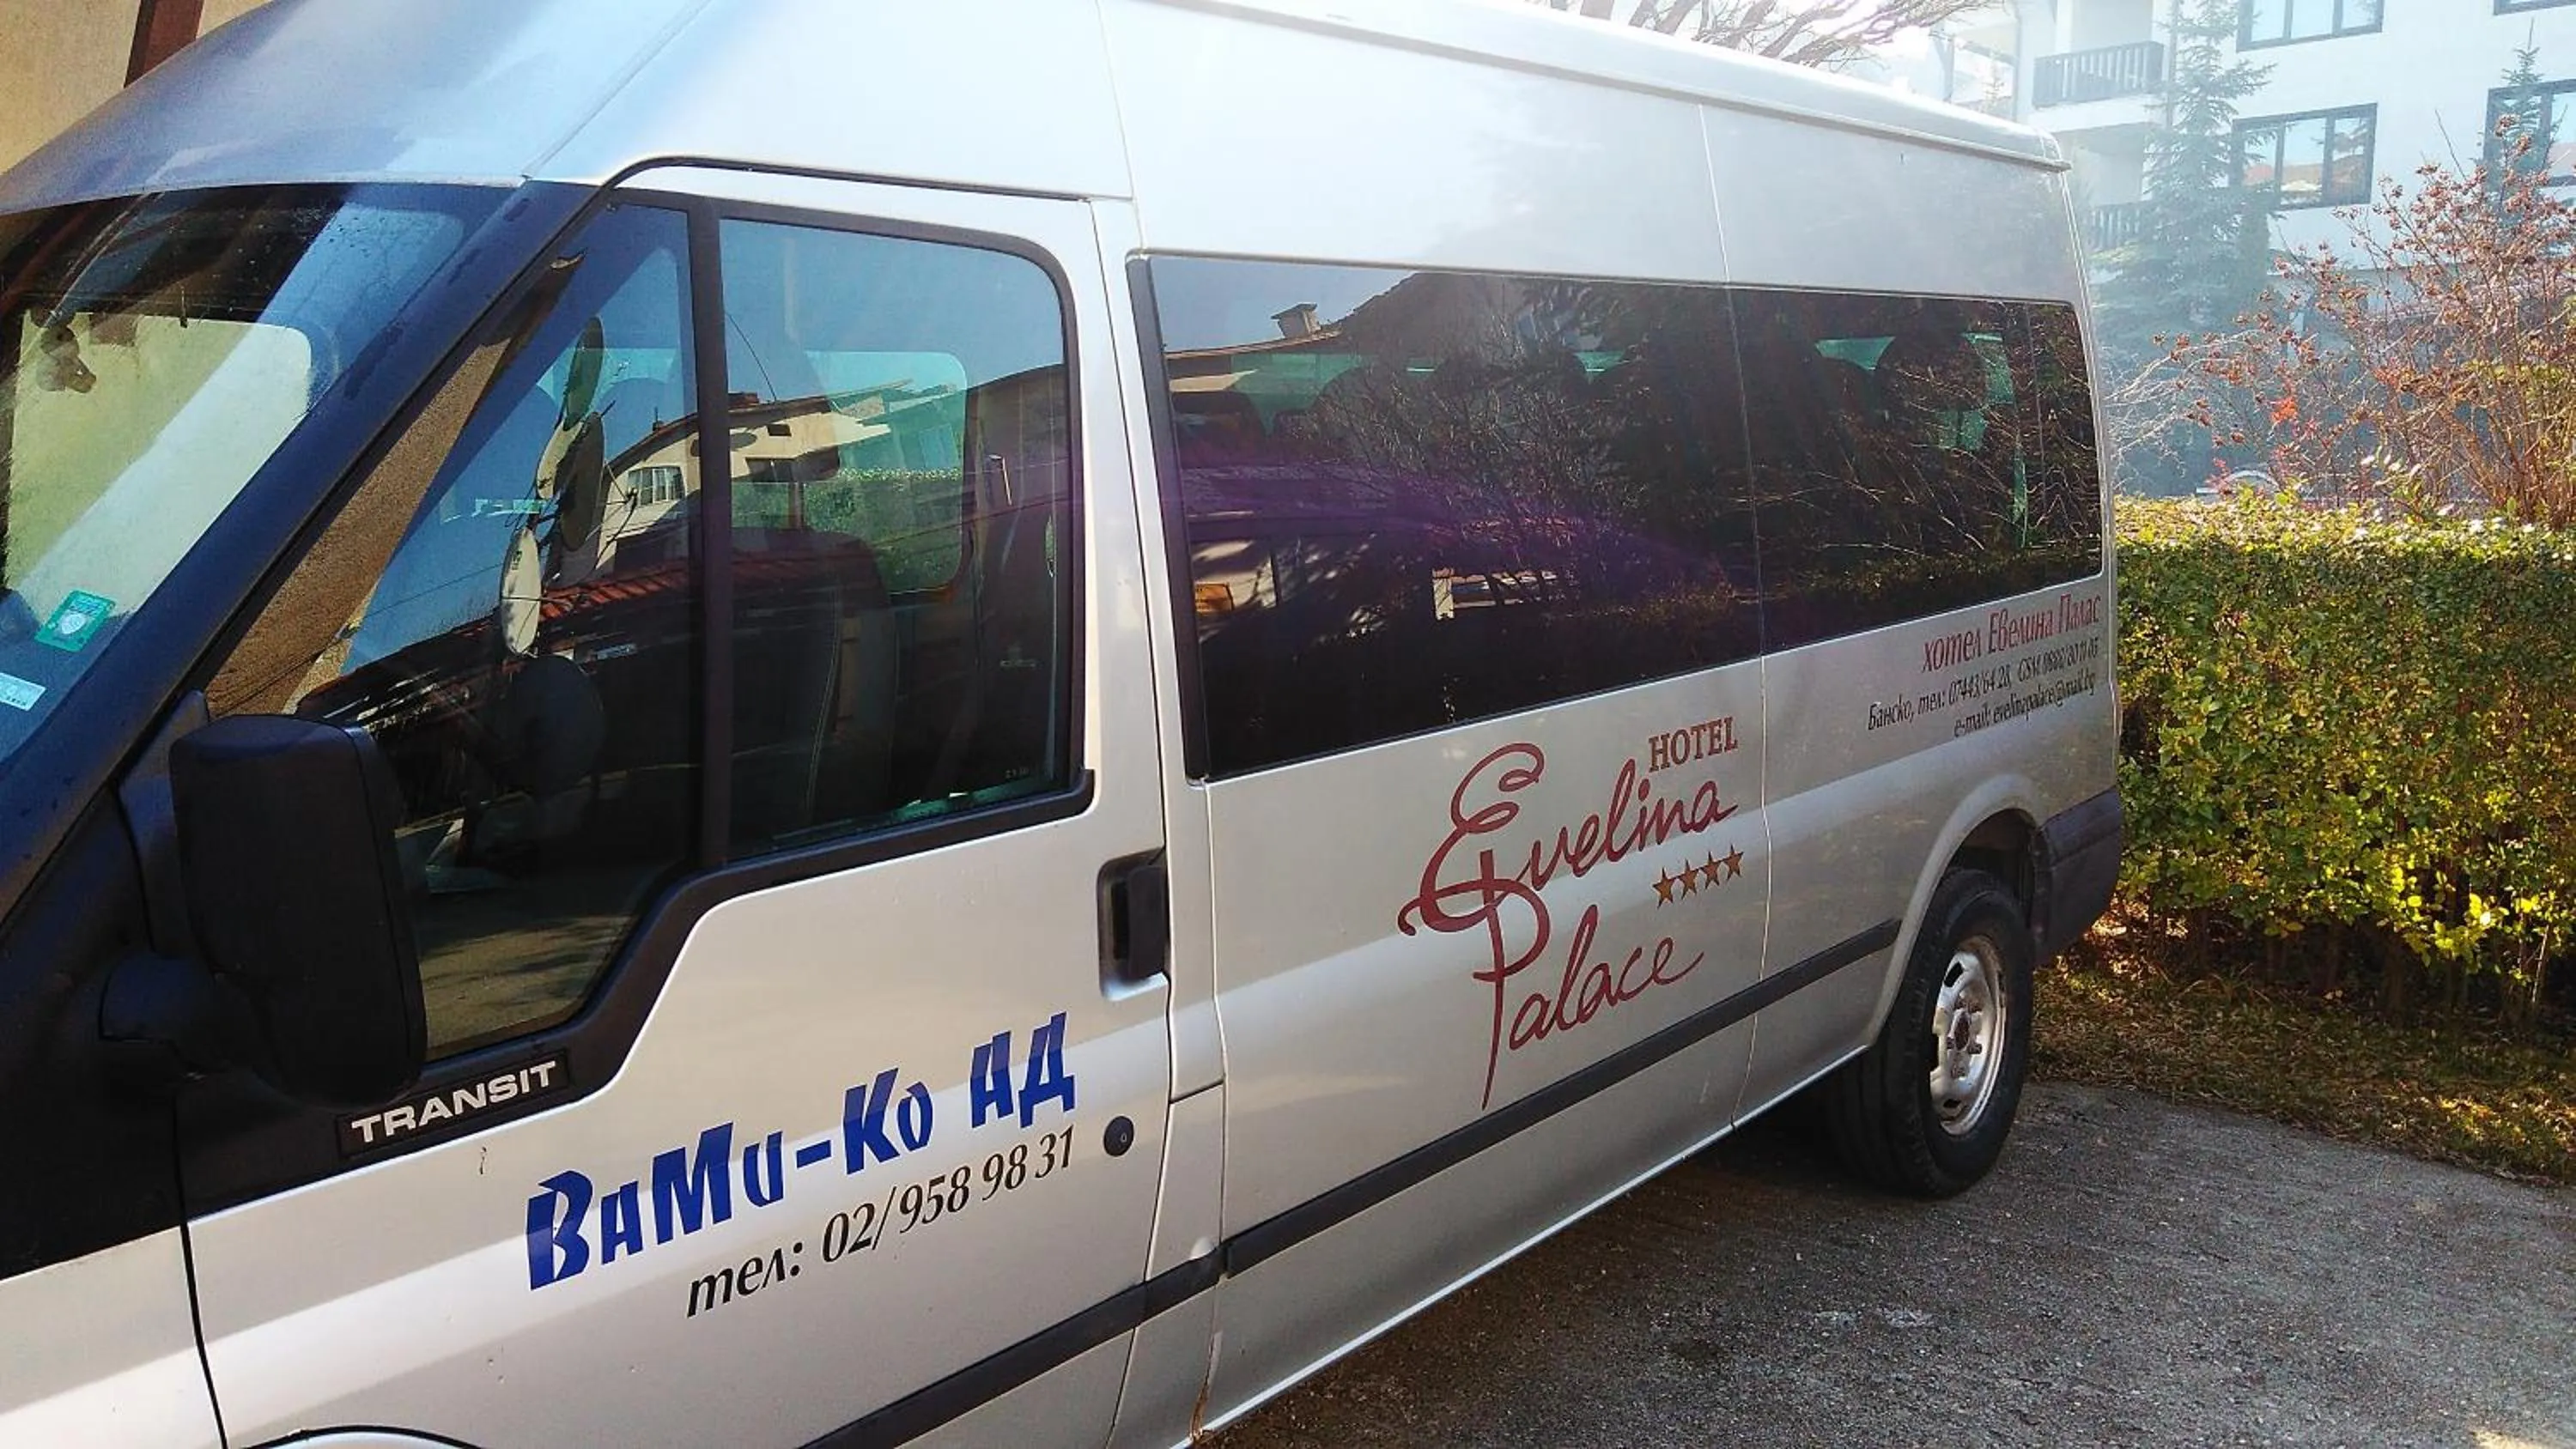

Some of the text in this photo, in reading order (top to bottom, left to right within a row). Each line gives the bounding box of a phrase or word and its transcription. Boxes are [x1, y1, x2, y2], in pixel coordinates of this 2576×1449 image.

[1922, 593, 2101, 673] хотел Евелина Палас
[1648, 716, 1740, 773] HOTEL
[1868, 693, 1915, 731] Банско,
[1917, 690, 1946, 715] тел:
[1397, 742, 1739, 936] Evelina
[1473, 848, 1704, 1112] Palace
[351, 1060, 556, 1143] TRANSIT
[969, 1010, 1076, 1130] АД
[686, 1124, 1074, 1319] тел: 02/958 98 31
